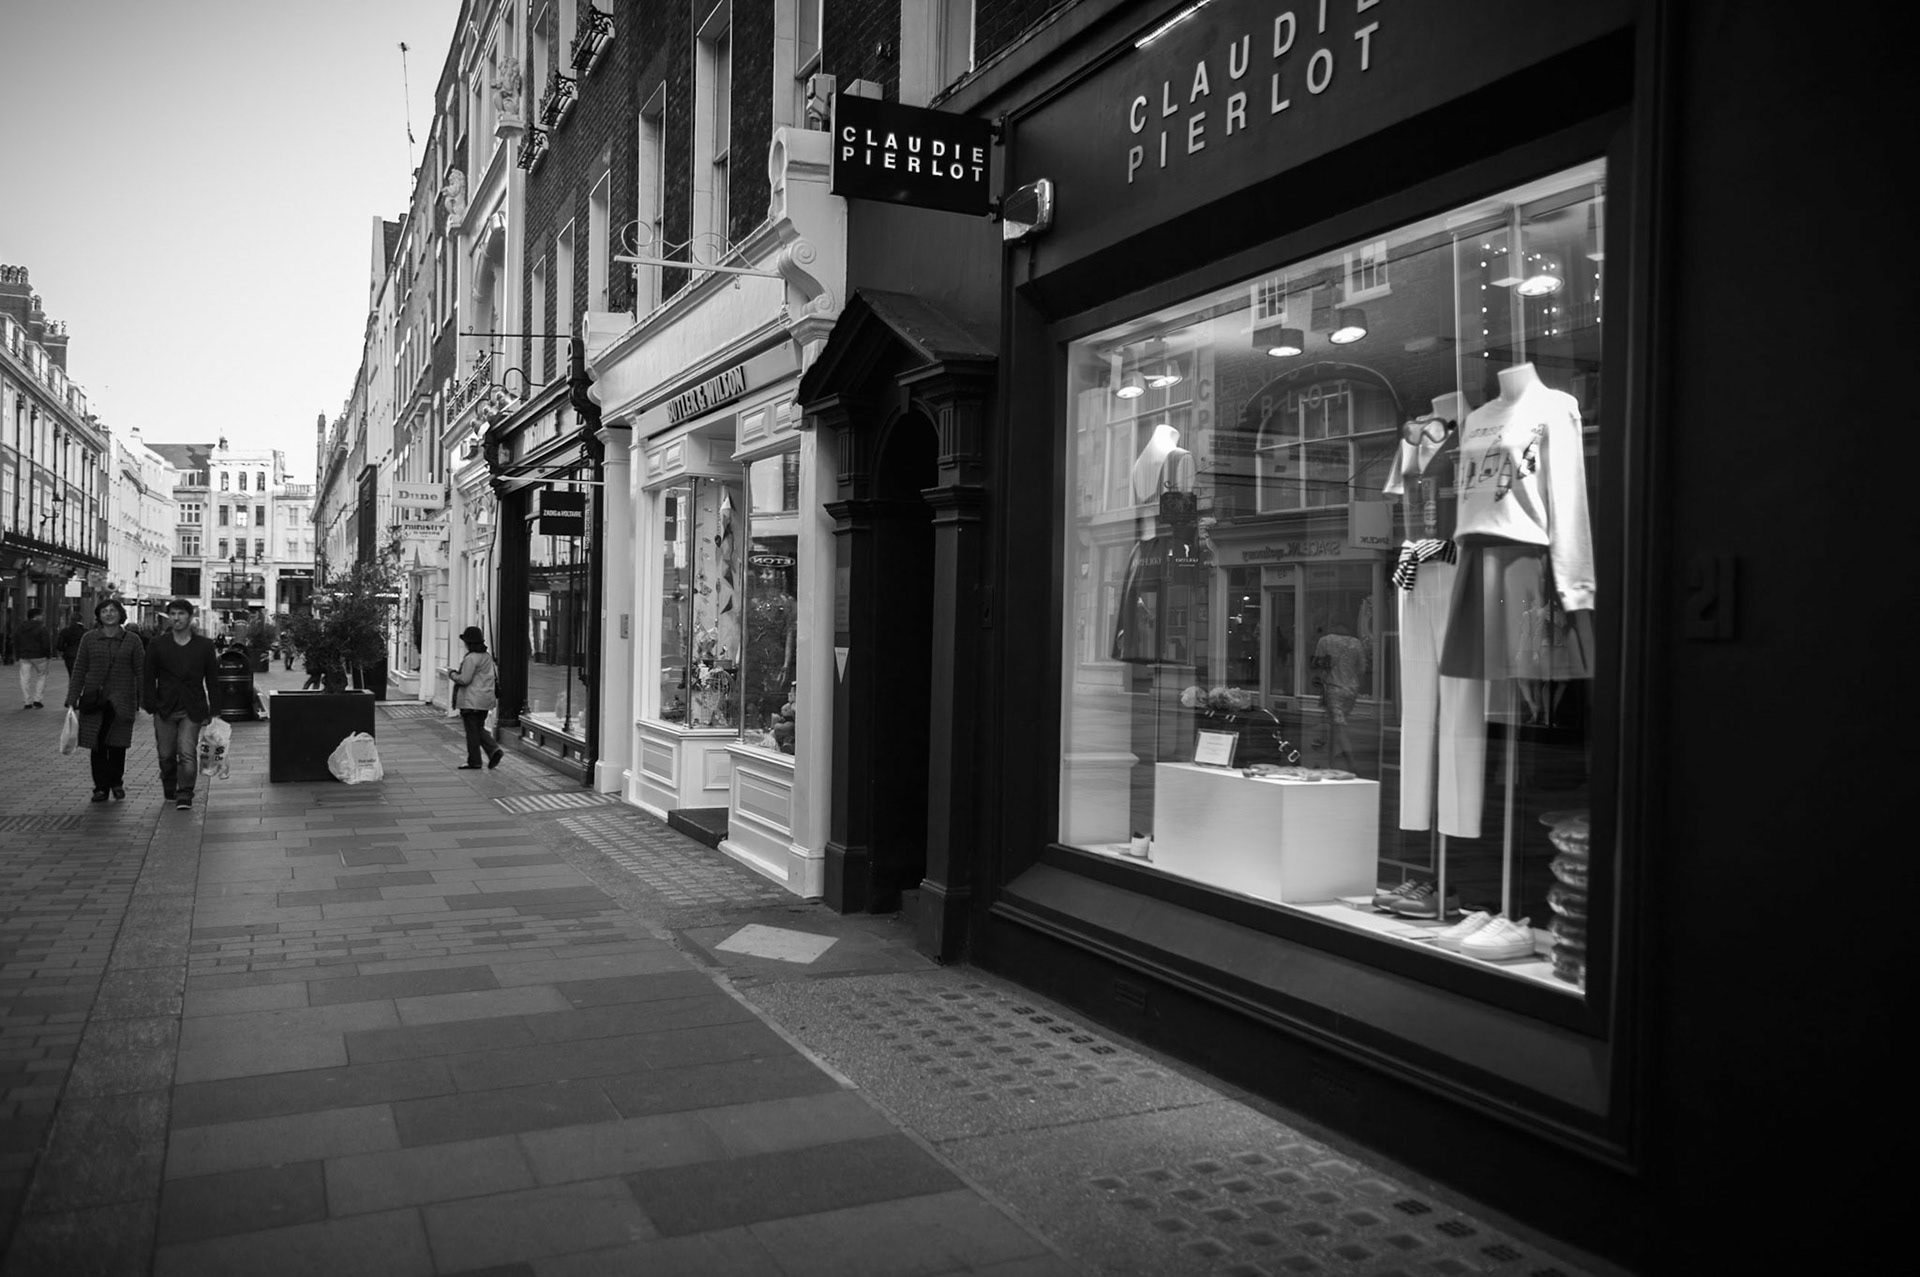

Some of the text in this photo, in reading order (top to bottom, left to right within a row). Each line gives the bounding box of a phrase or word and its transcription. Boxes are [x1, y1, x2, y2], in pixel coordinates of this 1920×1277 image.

[1129, 0, 1380, 134] CLAUDI
[1128, 21, 1379, 184] PIERLOT
[842, 126, 984, 163] CLAUDIE
[842, 145, 984, 182] PIERLOT
[666, 365, 747, 424] BUTLER & WILSON
[1198, 348, 1347, 402] CLAUDI
[398, 490, 438, 501] Dune
[1685, 552, 1735, 639] 21
